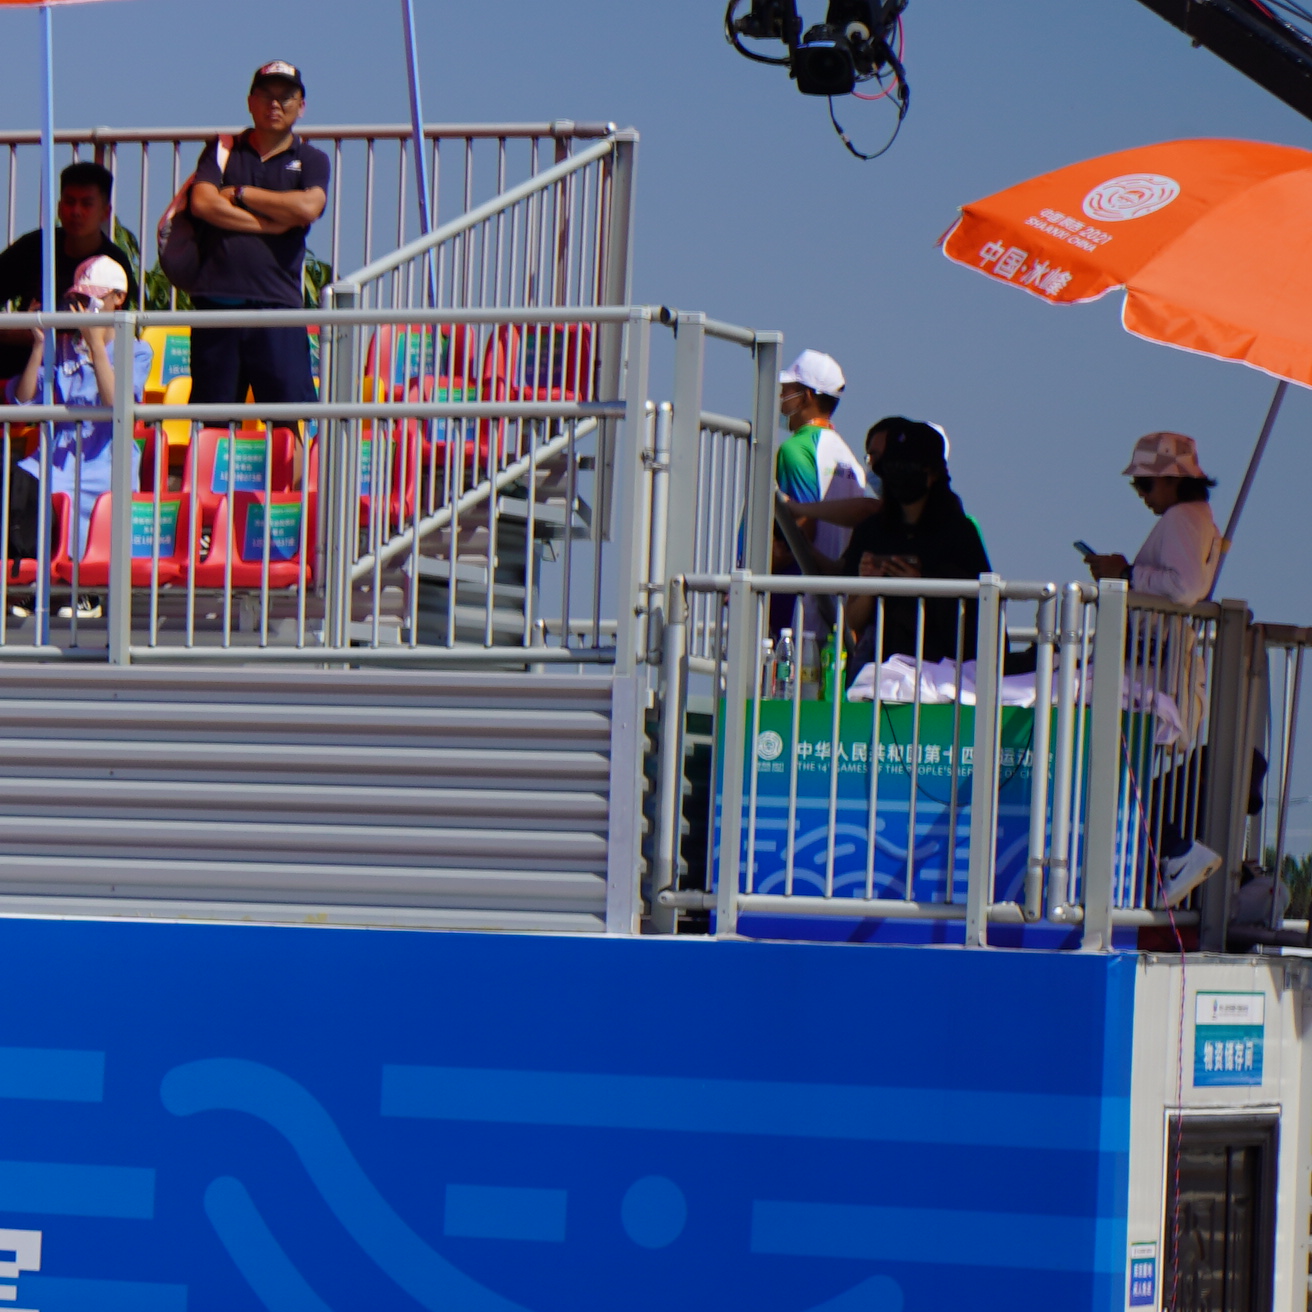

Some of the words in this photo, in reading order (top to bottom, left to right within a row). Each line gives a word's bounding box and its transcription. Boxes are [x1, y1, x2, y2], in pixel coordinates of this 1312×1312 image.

[1024, 216, 1068, 241] SHAANXI
[1069, 236, 1098, 253] CHINA
[1080, 225, 1113, 246] 2021
[979, 240, 1073, 297] 中国·冰峰
[797, 741, 1054, 768] 中华人民共和国第十四运动
[906, 765, 953, 777] POPLE'S
